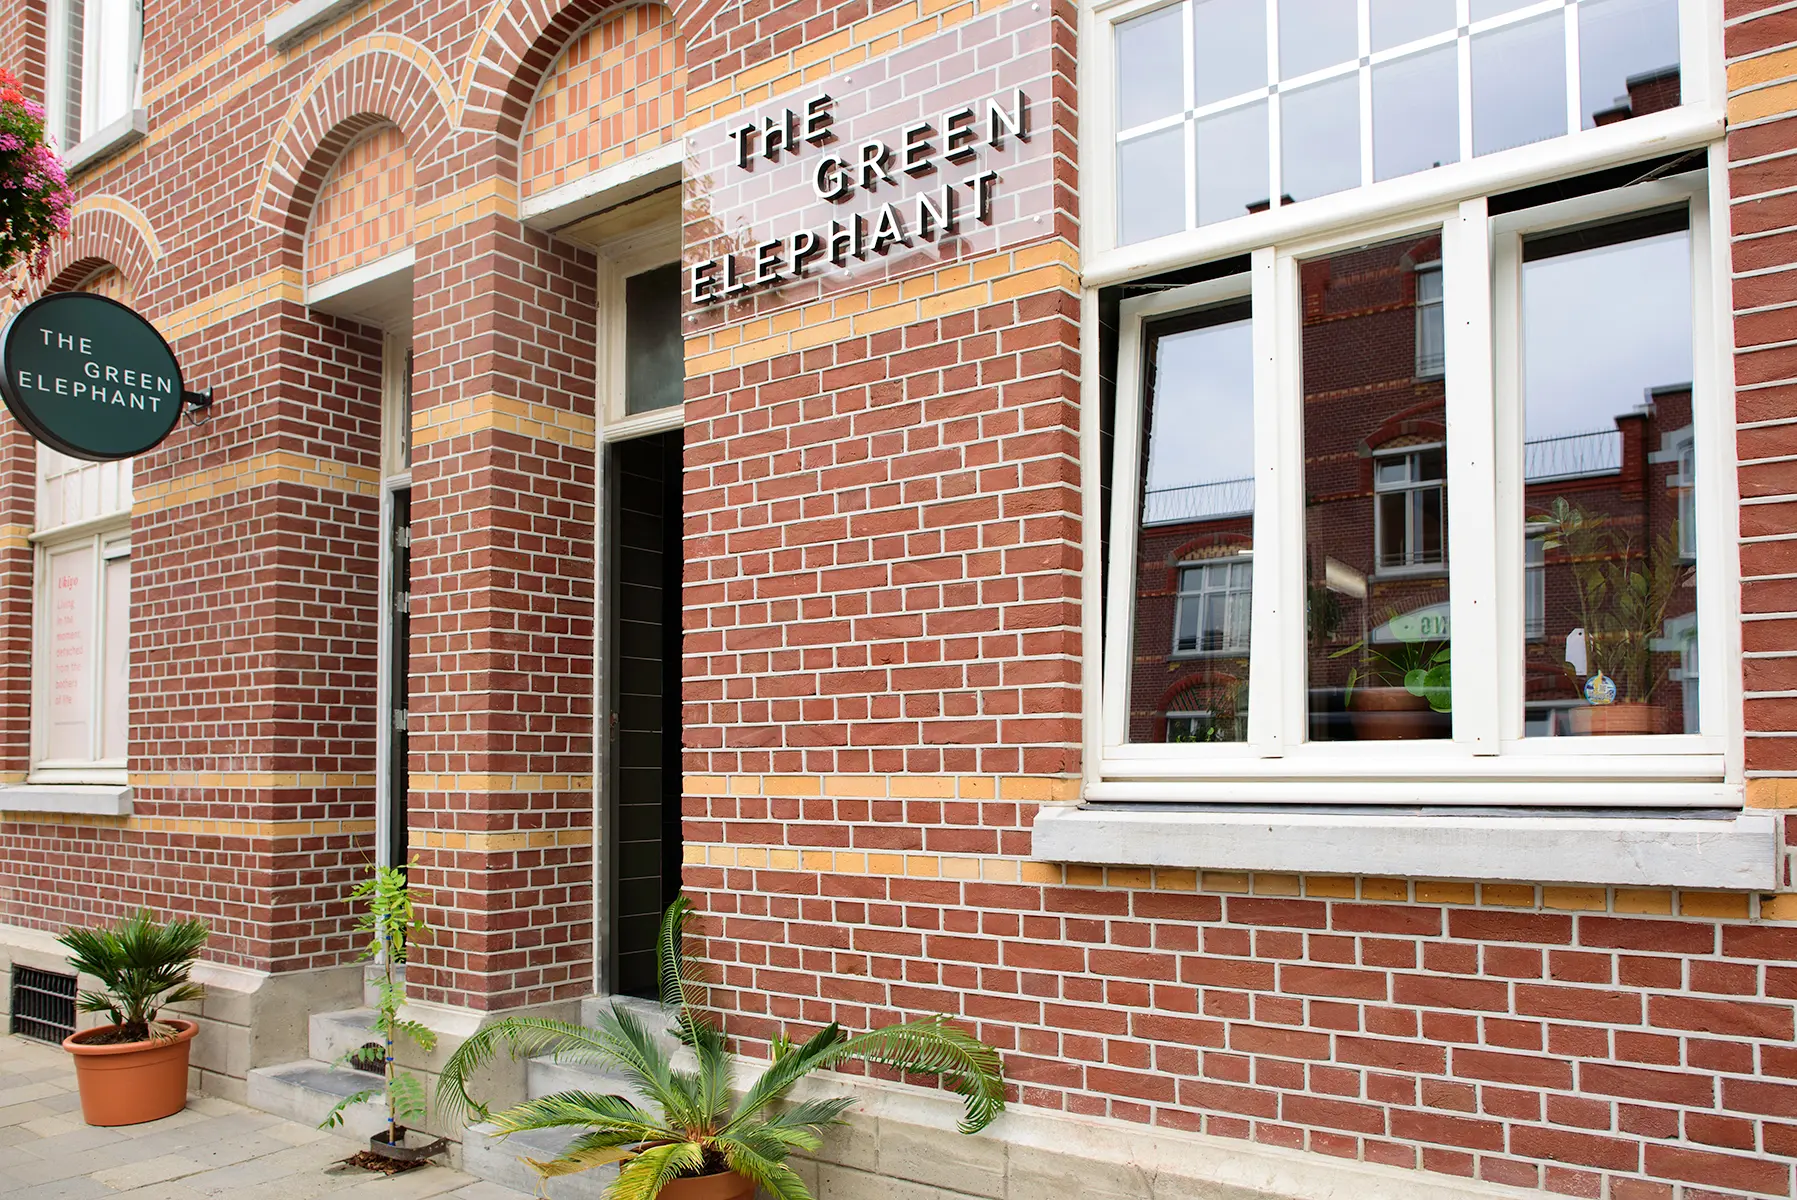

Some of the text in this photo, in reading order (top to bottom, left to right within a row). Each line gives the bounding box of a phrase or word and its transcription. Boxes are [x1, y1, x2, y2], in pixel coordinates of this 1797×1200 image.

[728, 93, 833, 169] THE
[812, 88, 1027, 201] GREEN
[690, 169, 998, 304] ELEPHANT
[40, 328, 92, 355] THE
[18, 370, 161, 413] ELEPHANT
[84, 361, 172, 394] GREEN
